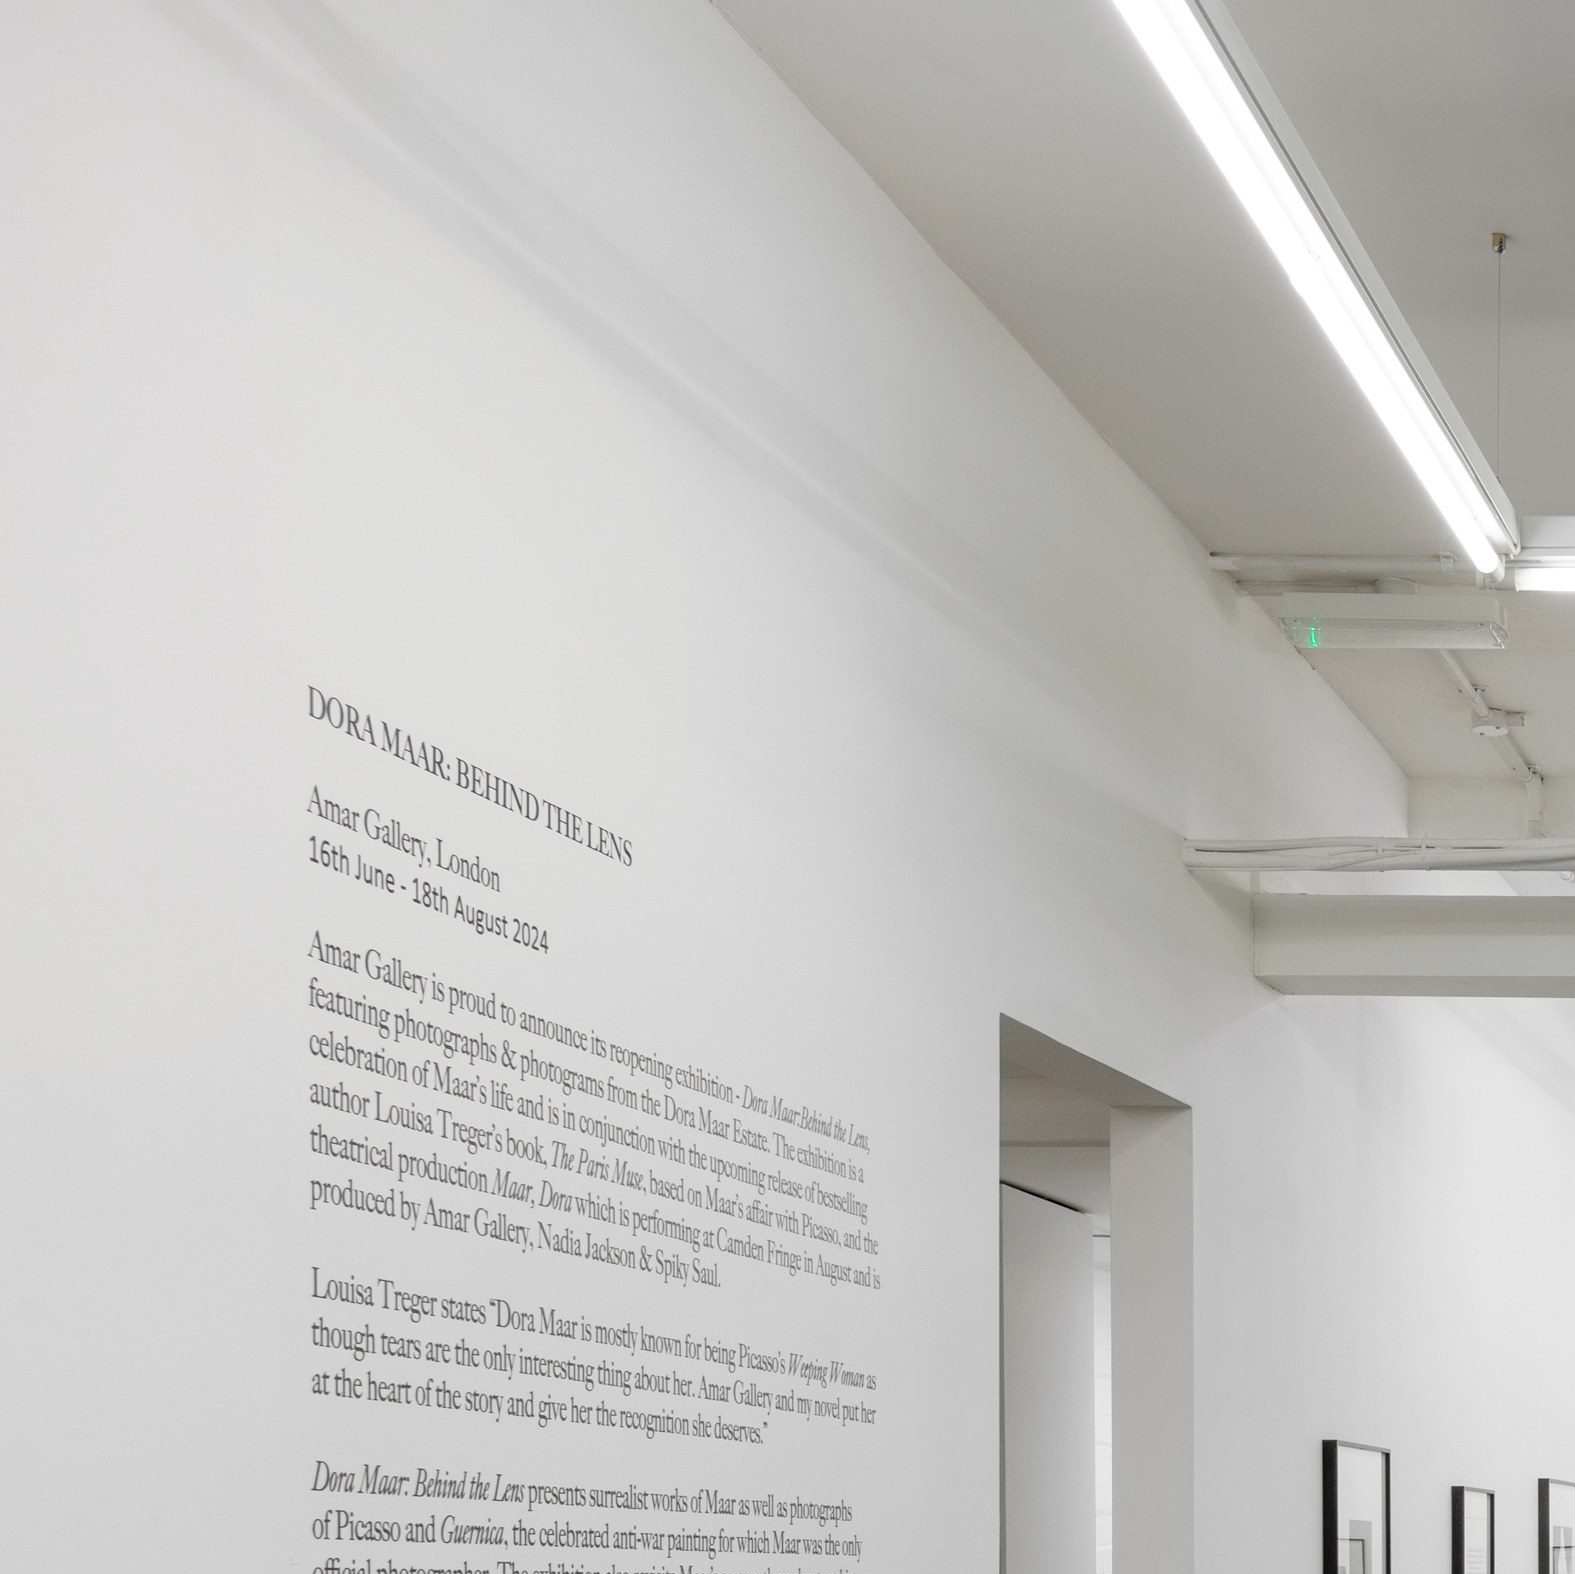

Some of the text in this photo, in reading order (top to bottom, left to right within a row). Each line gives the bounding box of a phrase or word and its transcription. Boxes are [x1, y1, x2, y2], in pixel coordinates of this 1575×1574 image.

[307, 684, 633, 867] DORA MAAR: BEHIND THE LENS
[306, 784, 501, 893] Amar Gallery, London
[309, 835, 350, 877] 16th
[354, 854, 396, 894] June
[412, 877, 449, 916] 18th
[453, 894, 509, 940] August
[512, 918, 549, 955] 2024
[307, 929, 361, 975] Amar
[364, 948, 429, 1005] Gallery
[431, 972, 445, 1003] is
[447, 986, 497, 1020] proud
[499, 1001, 517, 1027] to
[519, 1011, 588, 1052] announce
[590, 1029, 607, 1059] its
[609, 1043, 674, 1090] reopening
[675, 1064, 734, 1105] exhibition
[741, 1084, 768, 1115] Dora
[833, 1118, 847, 1143] the
[847, 1123, 870, 1155] Lens,
[309, 1178, 721, 1288] produced by Amar Gallery, Nadia Jackson & Spiky Saul.
[311, 1266, 375, 1307] Louisa
[377, 1277, 438, 1324] Treger
[441, 1297, 487, 1325] states
[538, 1306, 579, 1340] Maar
[580, 1315, 592, 1342] is
[594, 1322, 639, 1357] mostly
[640, 1325, 683, 1358] known
[684, 1333, 703, 1361] for
[703, 1336, 737, 1374] being
[788, 1352, 829, 1389] Weeping
[829, 1360, 865, 1389] Woman
[866, 1374, 877, 1391] as
[311, 1371, 331, 1396] at
[333, 1367, 363, 1399] the
[366, 1370, 412, 1405] heart
[414, 1377, 435, 1407] of
[434, 1380, 462, 1410] the
[464, 1390, 505, 1423] story
[506, 1390, 535, 1418] and
[537, 1394, 568, 1429] give
[570, 1396, 594, 1425] her
[595, 1399, 617, 1428] the
[619, 1408, 690, 1440] recognition
[691, 1412, 712, 1439] she
[311, 1509, 863, 1563] of Picasso and Guernica, the celebrated anti-war painting for which Maar was the only
